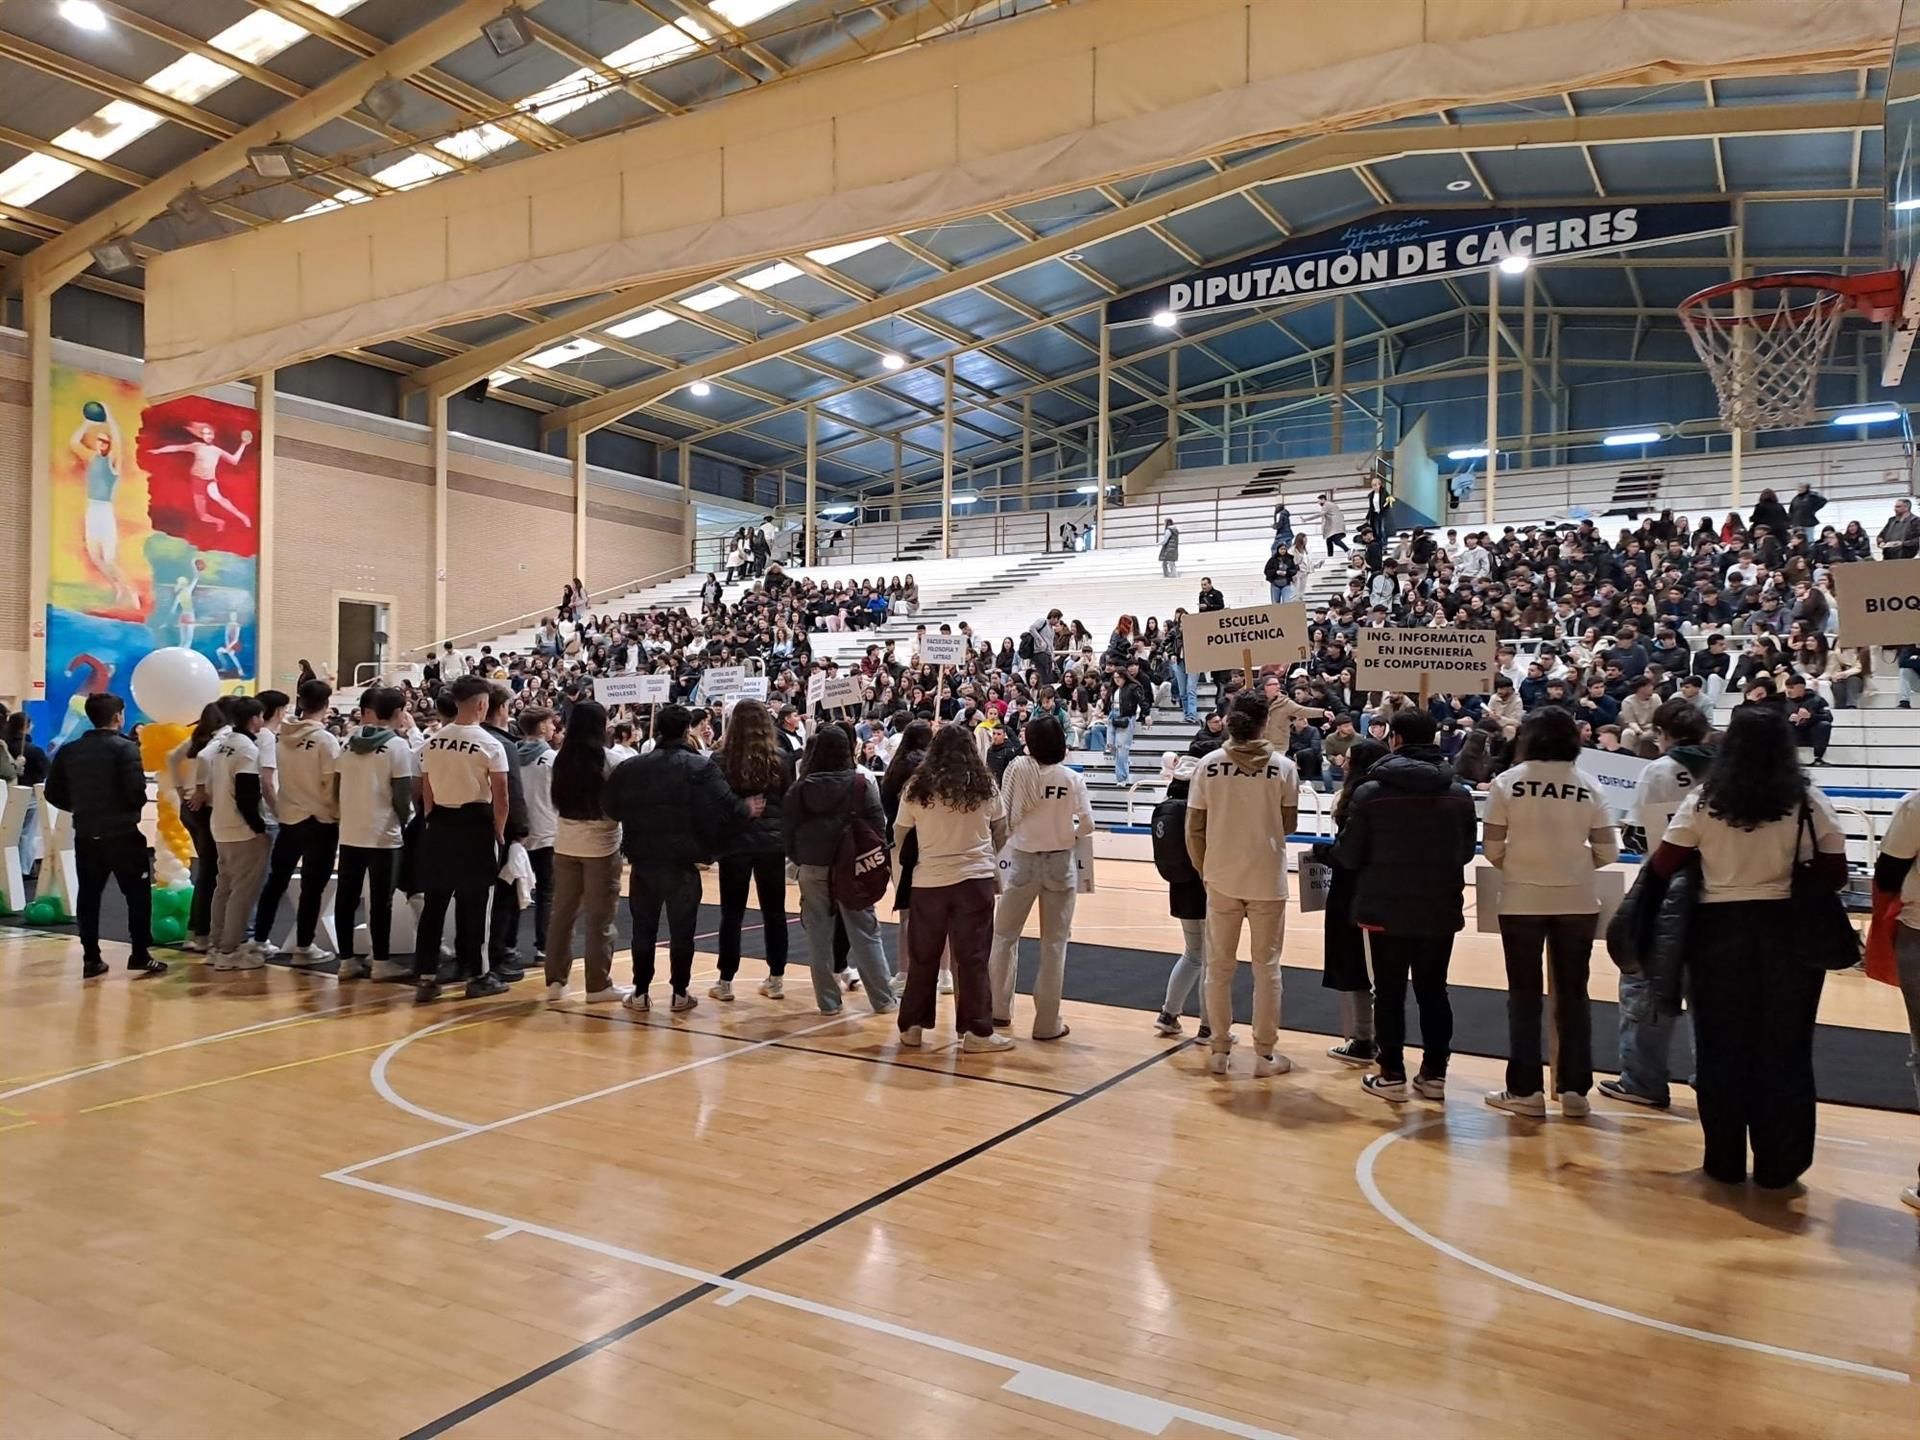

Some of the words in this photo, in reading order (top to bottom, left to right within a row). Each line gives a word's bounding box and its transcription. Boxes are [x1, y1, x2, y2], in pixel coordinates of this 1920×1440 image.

[1169, 249, 1387, 311] DIPUTACIÓN
[1398, 240, 1447, 276] DE
[1456, 208, 1638, 266] CÁCERES
[1219, 613, 1270, 629] ESCUELA
[1207, 627, 1285, 645] POLITÉCNICA
[1367, 632, 1394, 641] ING.
[1399, 632, 1486, 643] INFORMÁTICA
[1378, 645, 1395, 655] EN
[1399, 645, 1473, 657] INGENIERÍA
[1364, 658, 1380, 668] DE
[1384, 659, 1487, 671] COMPUTADORES
[430, 738, 480, 755] STAFF
[1512, 780, 1592, 802] STAFF
